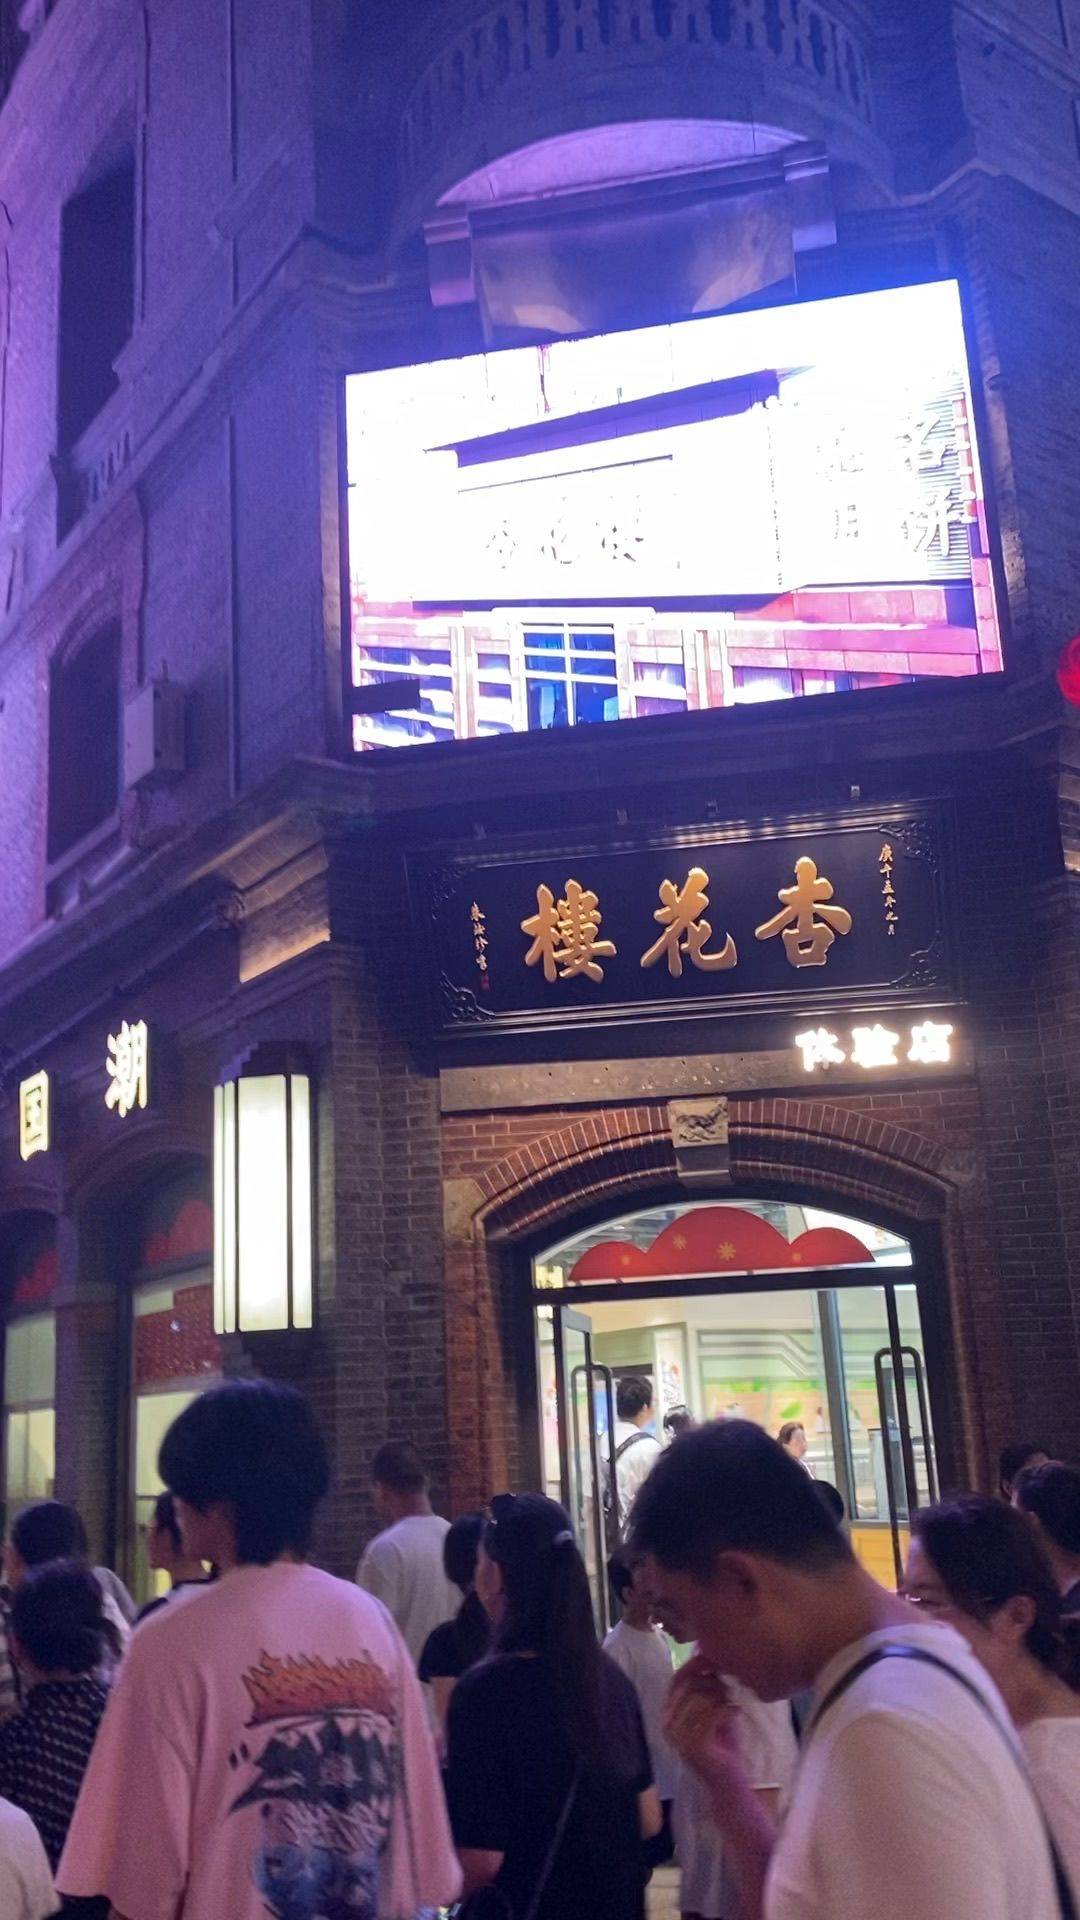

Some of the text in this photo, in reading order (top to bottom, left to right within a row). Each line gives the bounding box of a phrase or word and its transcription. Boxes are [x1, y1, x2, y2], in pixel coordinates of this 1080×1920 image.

[521, 856, 852, 983] 杏花樓
[795, 1020, 954, 1072] 体验店
